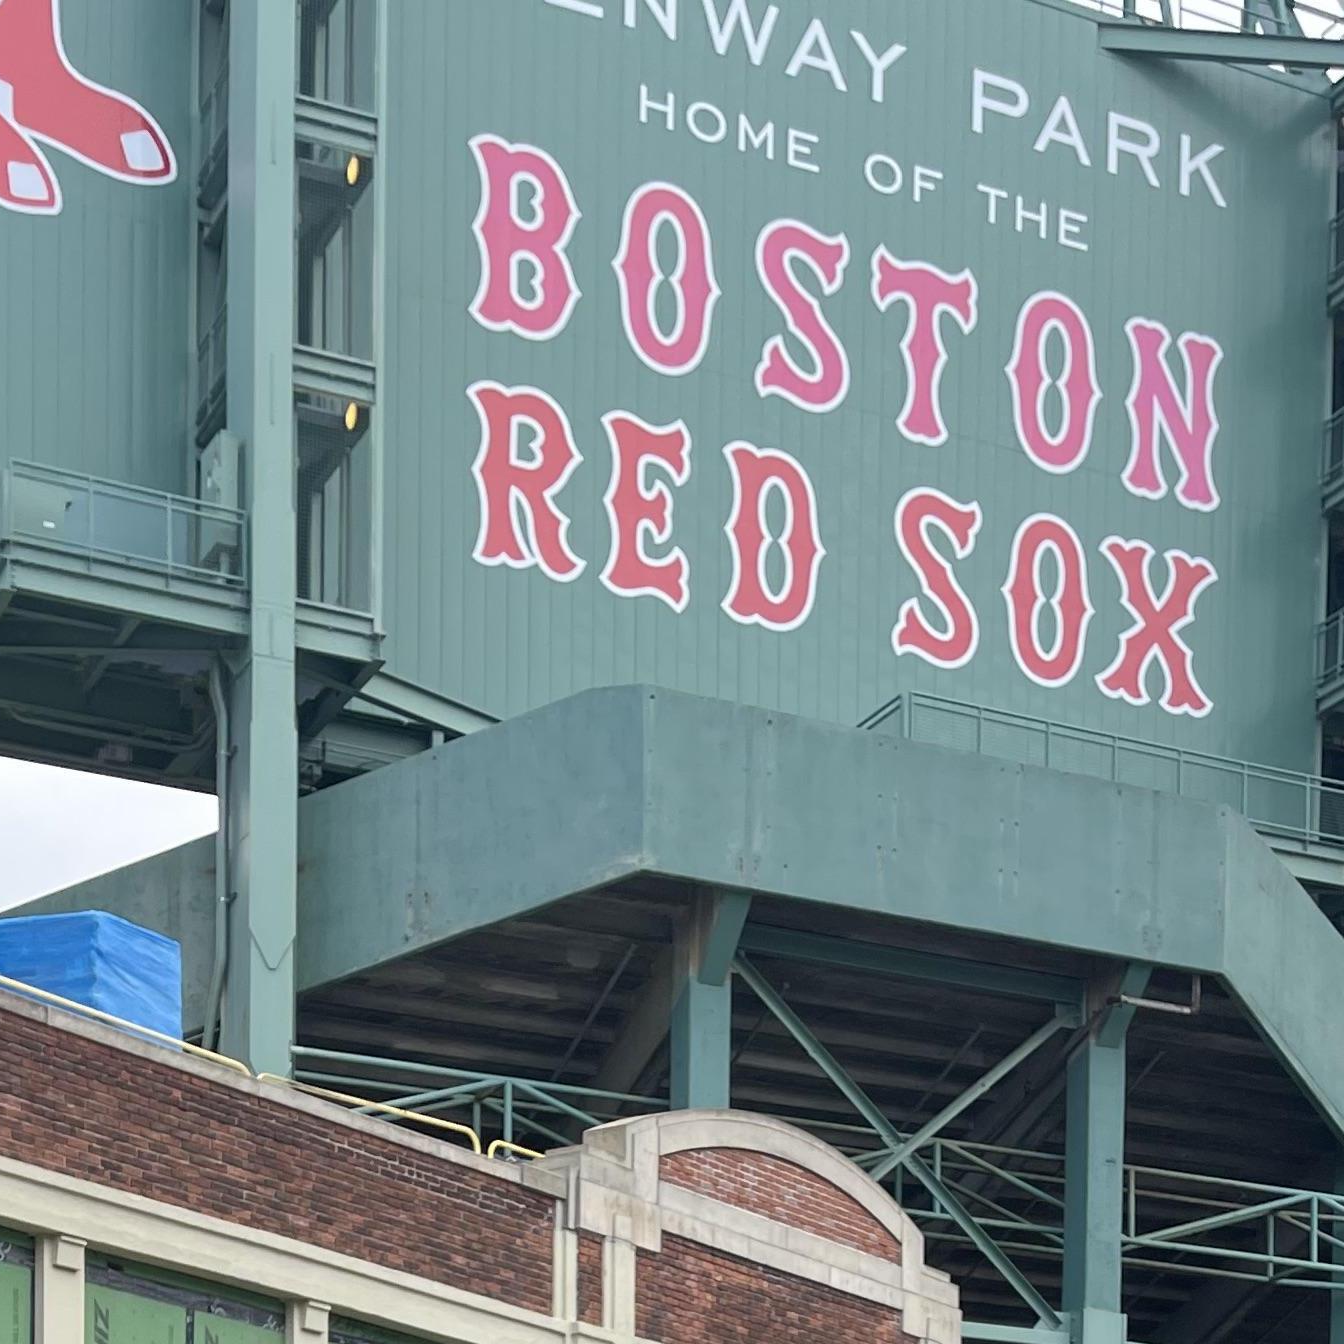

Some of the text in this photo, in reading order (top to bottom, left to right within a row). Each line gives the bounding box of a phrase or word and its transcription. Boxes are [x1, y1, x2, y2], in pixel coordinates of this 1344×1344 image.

[637, 83, 1090, 252] HOME OF THE
[970, 67, 1228, 209] PARK
[467, 133, 1224, 513] BOSTON
[465, 379, 1219, 718] RED SOX
